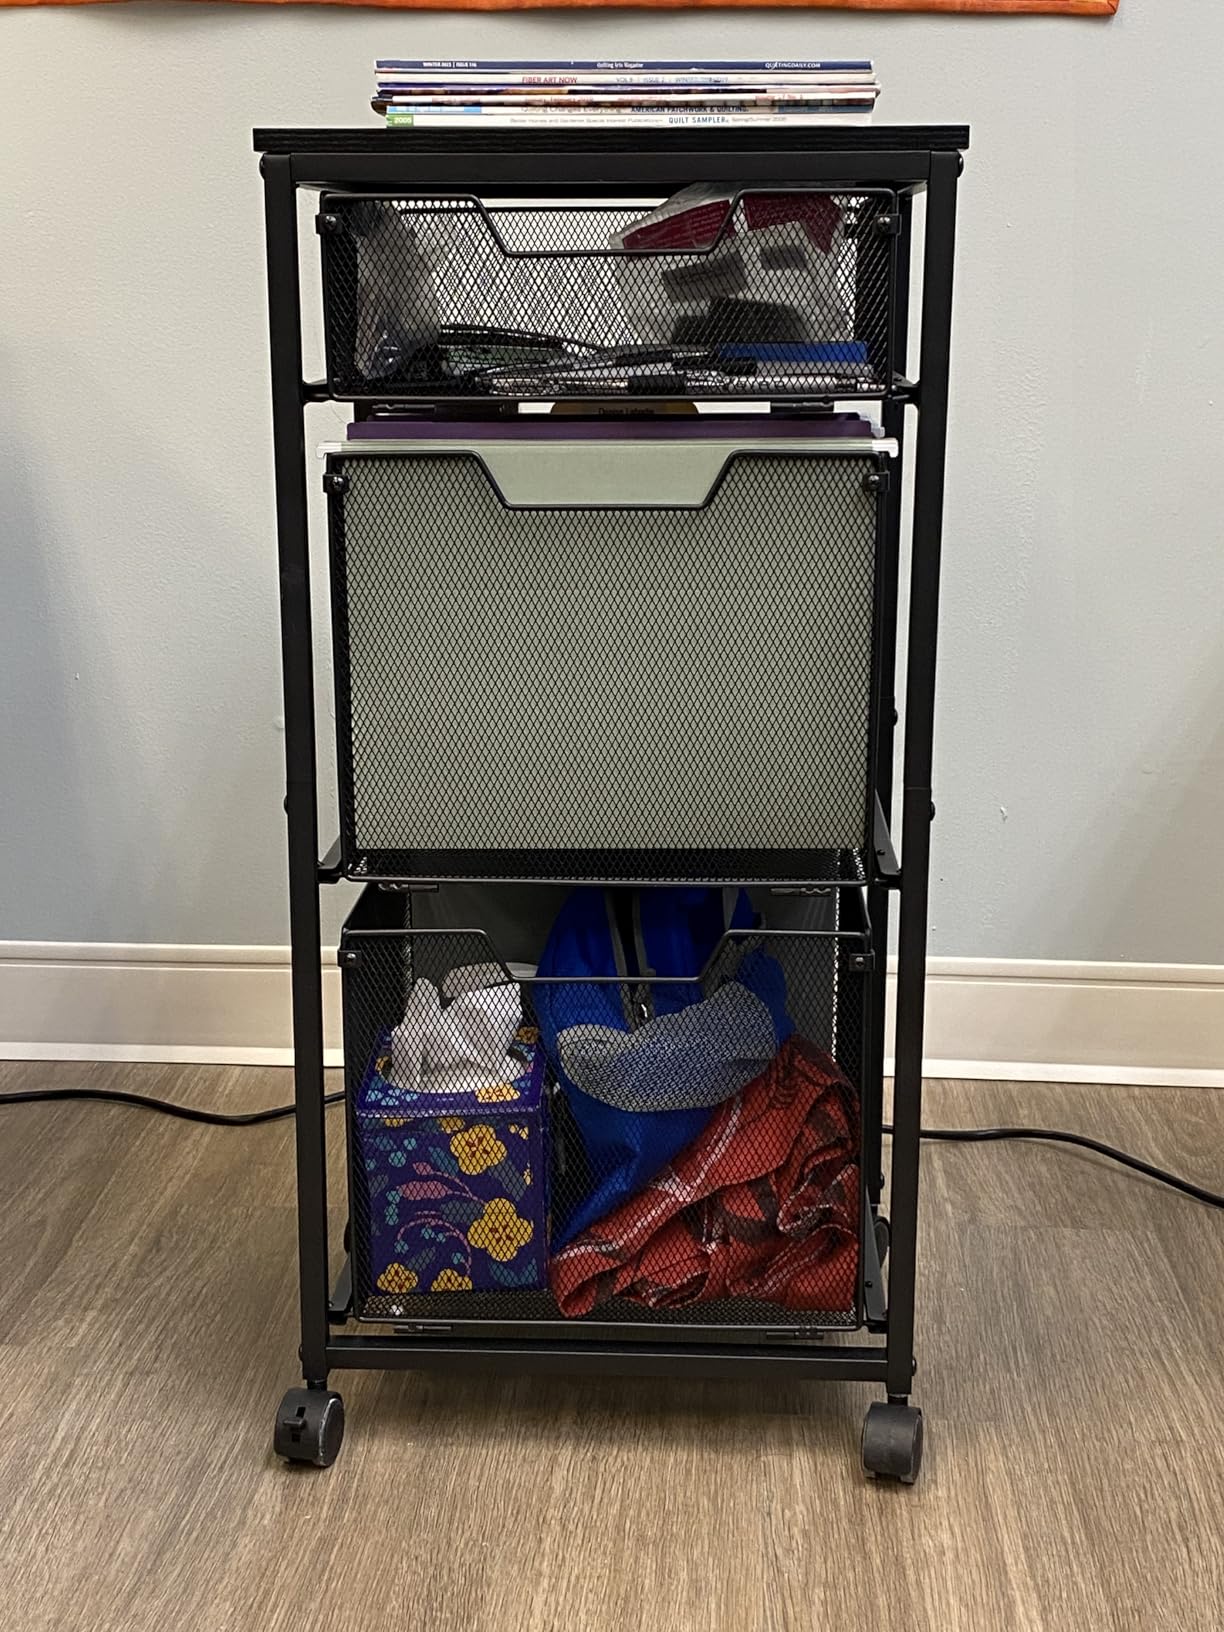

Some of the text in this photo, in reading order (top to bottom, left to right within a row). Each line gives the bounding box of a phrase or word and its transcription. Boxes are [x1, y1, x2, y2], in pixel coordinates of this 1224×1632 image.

[521, 76, 578, 84] FIBER ART NOW
[668, 116, 689, 124] QUILT
